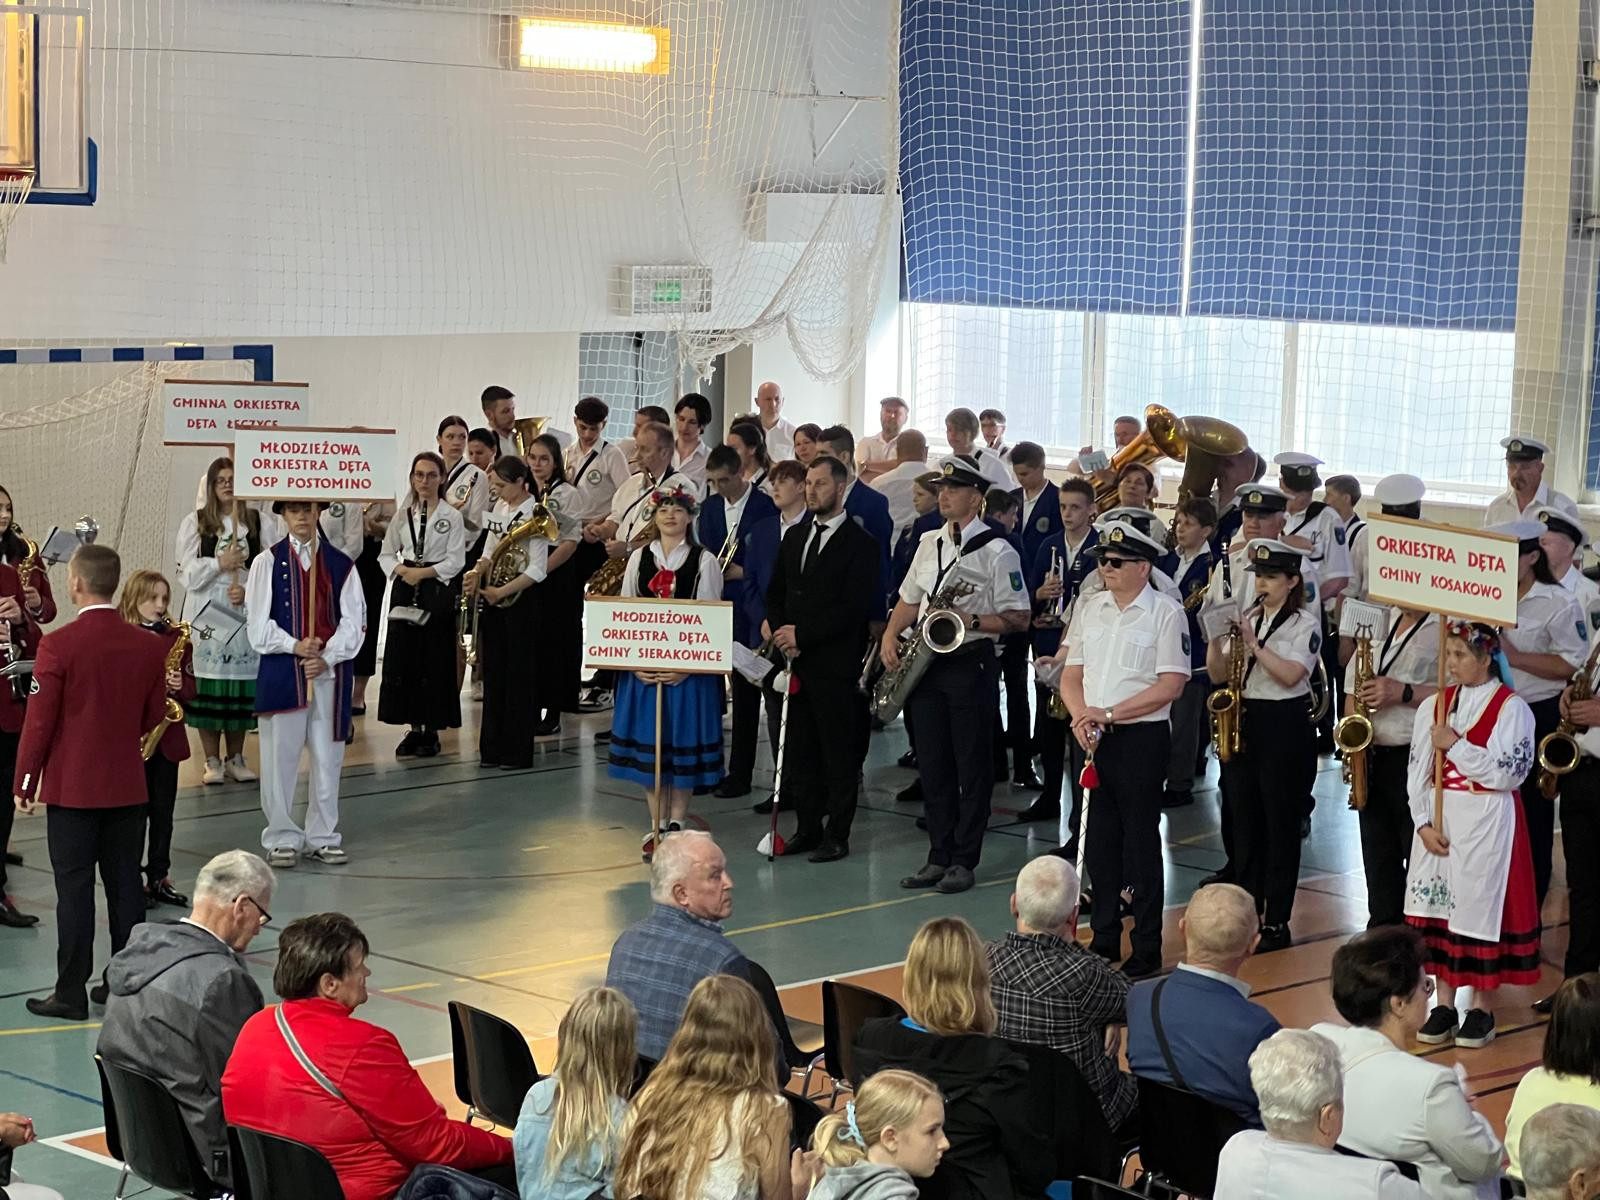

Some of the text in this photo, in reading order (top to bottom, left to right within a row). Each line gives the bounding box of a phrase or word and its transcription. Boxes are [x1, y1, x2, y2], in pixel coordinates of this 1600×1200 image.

[173, 398, 301, 411] GMINNA ORKIESTRA
[187, 418, 217, 429] DĘTA
[260, 441, 361, 456] MŁODZIEŻOWA
[252, 458, 371, 474] ORKIESTRA DĘTA
[252, 476, 372, 490] OSP POSTOMINO
[1376, 535, 1506, 573] ORKIESTRA DĘTA
[1379, 566, 1502, 600] GMINY KOSAKOWO
[612, 610, 702, 625] MŁODZIEŻOWA
[602, 628, 710, 645] ORKIESTRA DĘTA
[588, 646, 723, 662] GMINY SIERAKOWICE
